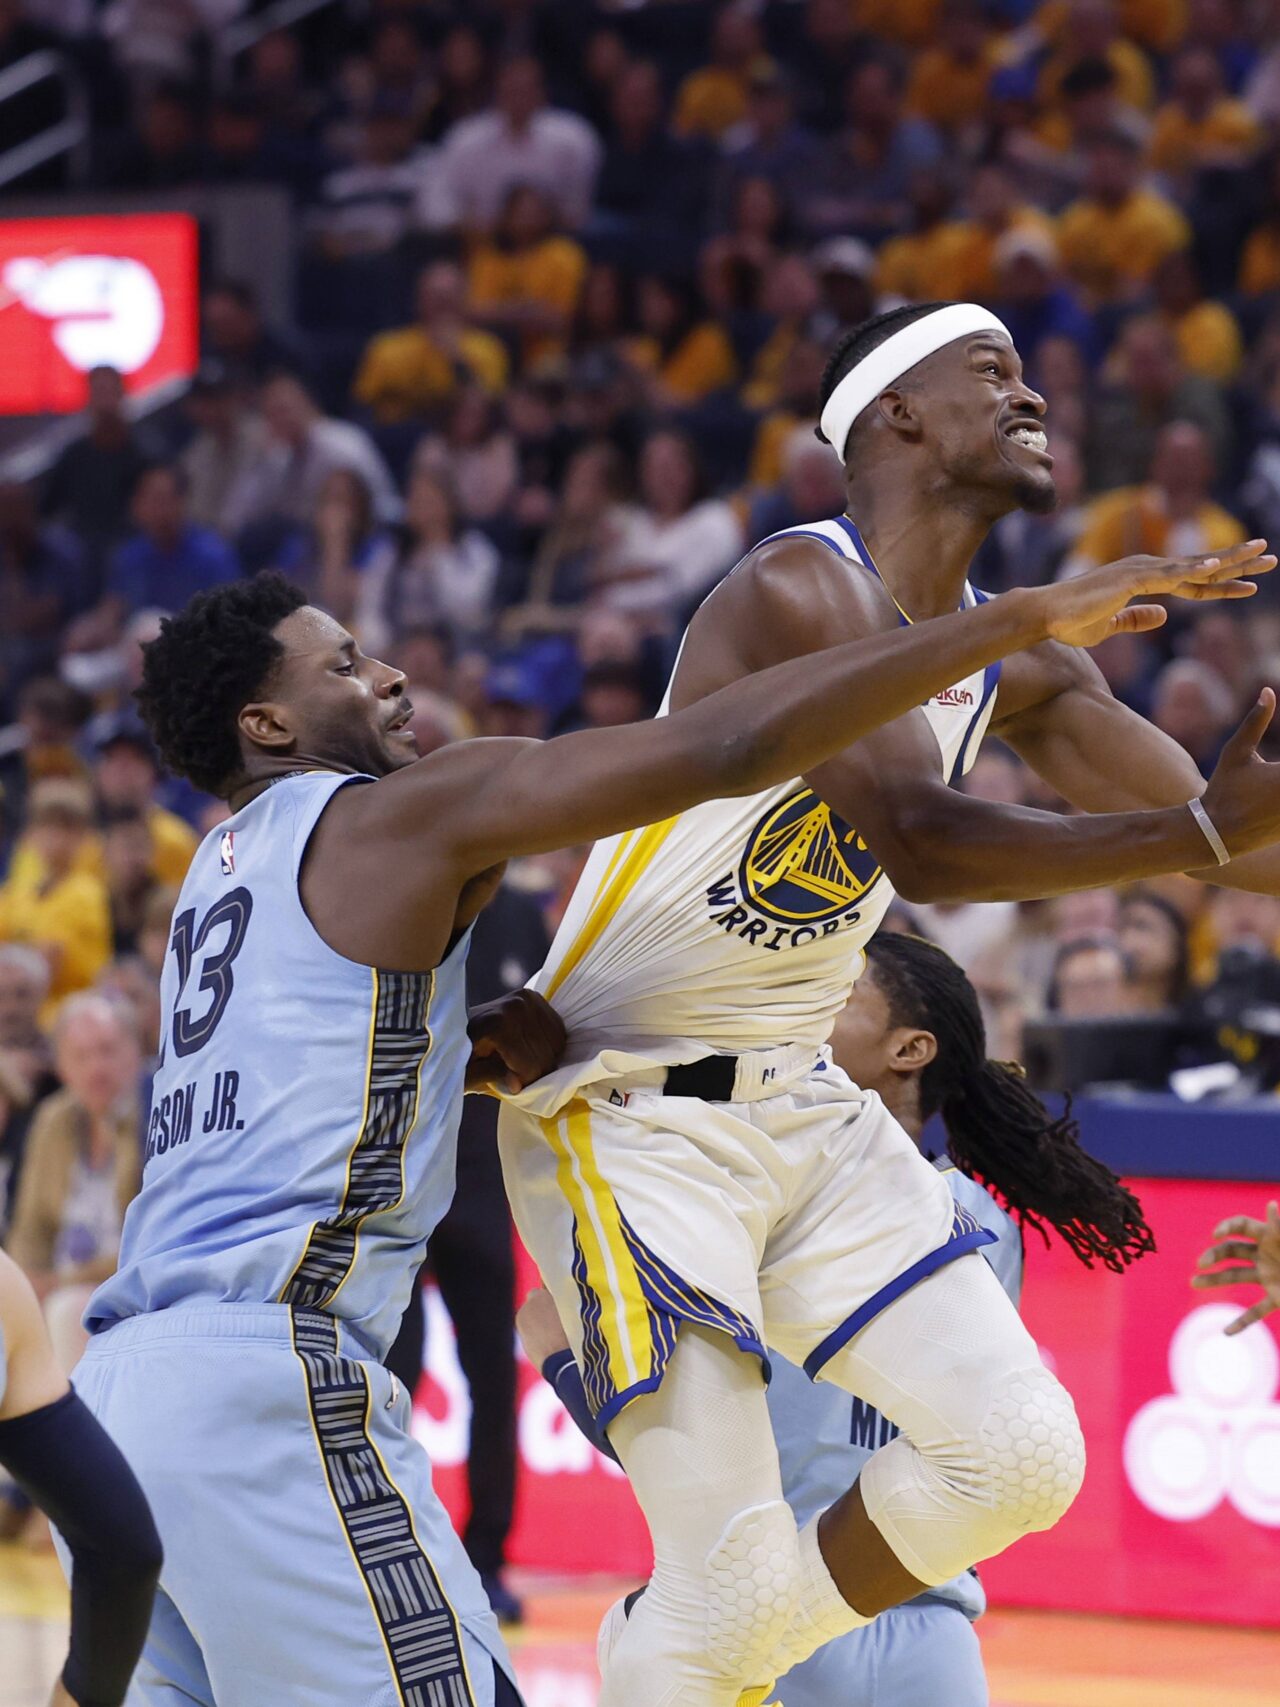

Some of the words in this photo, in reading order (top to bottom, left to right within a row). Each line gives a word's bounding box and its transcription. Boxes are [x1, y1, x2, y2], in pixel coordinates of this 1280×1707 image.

[706, 871, 861, 951] WRRIORS
[168, 886, 254, 1060] 13
[202, 1069, 245, 1134] JR.
